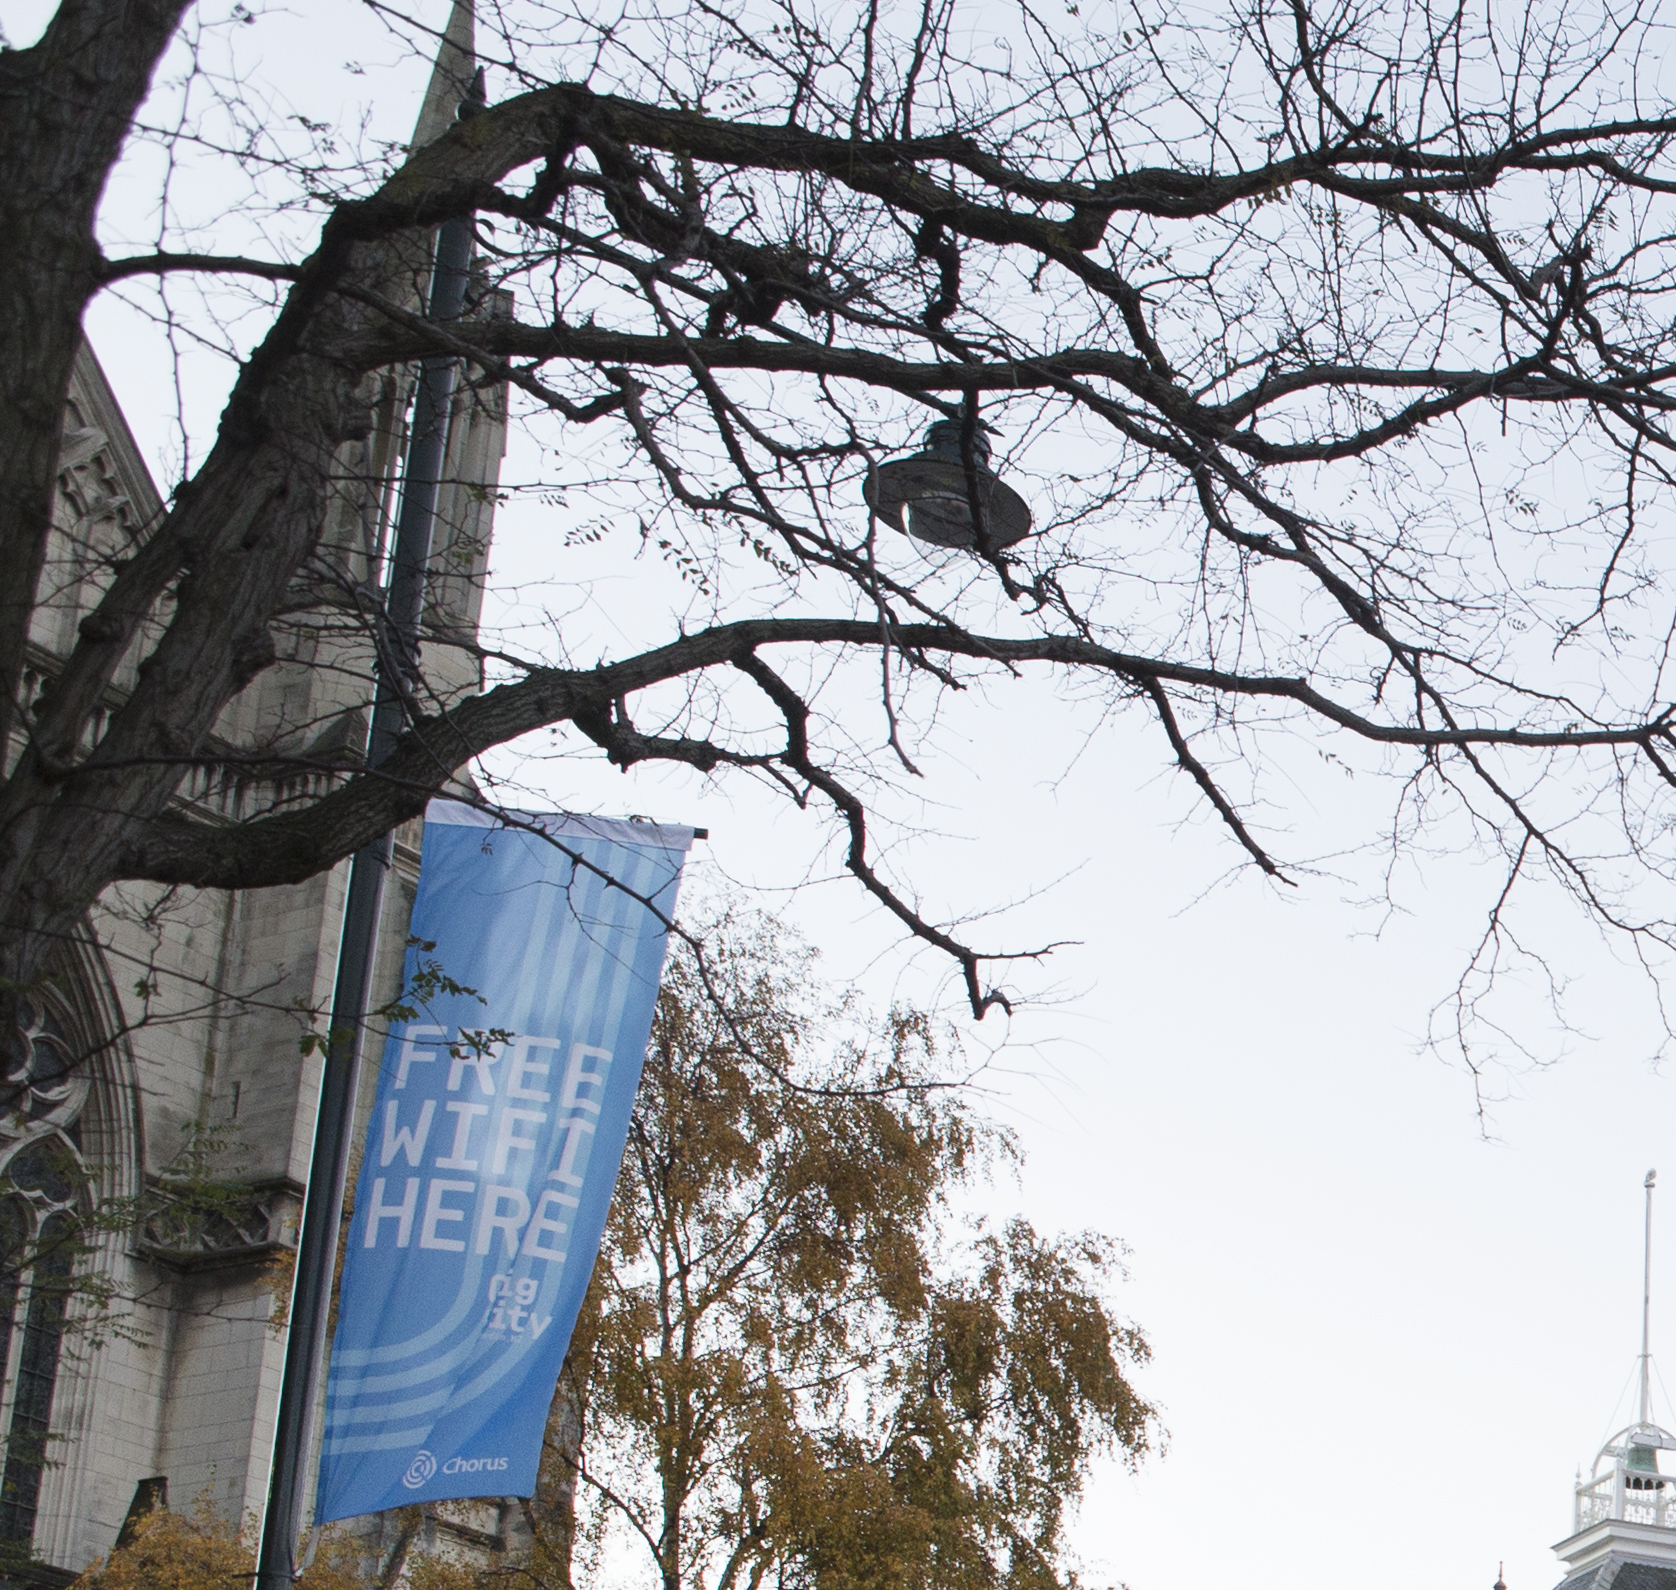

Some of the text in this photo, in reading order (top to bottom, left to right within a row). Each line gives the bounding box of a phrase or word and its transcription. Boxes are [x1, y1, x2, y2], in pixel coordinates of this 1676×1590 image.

[394, 1024, 614, 1115] FREE
[380, 1099, 596, 1188] WIFI
[363, 1177, 581, 1262] HERE
[488, 1299, 553, 1340] ity
[441, 1456, 509, 1475] Chorus
